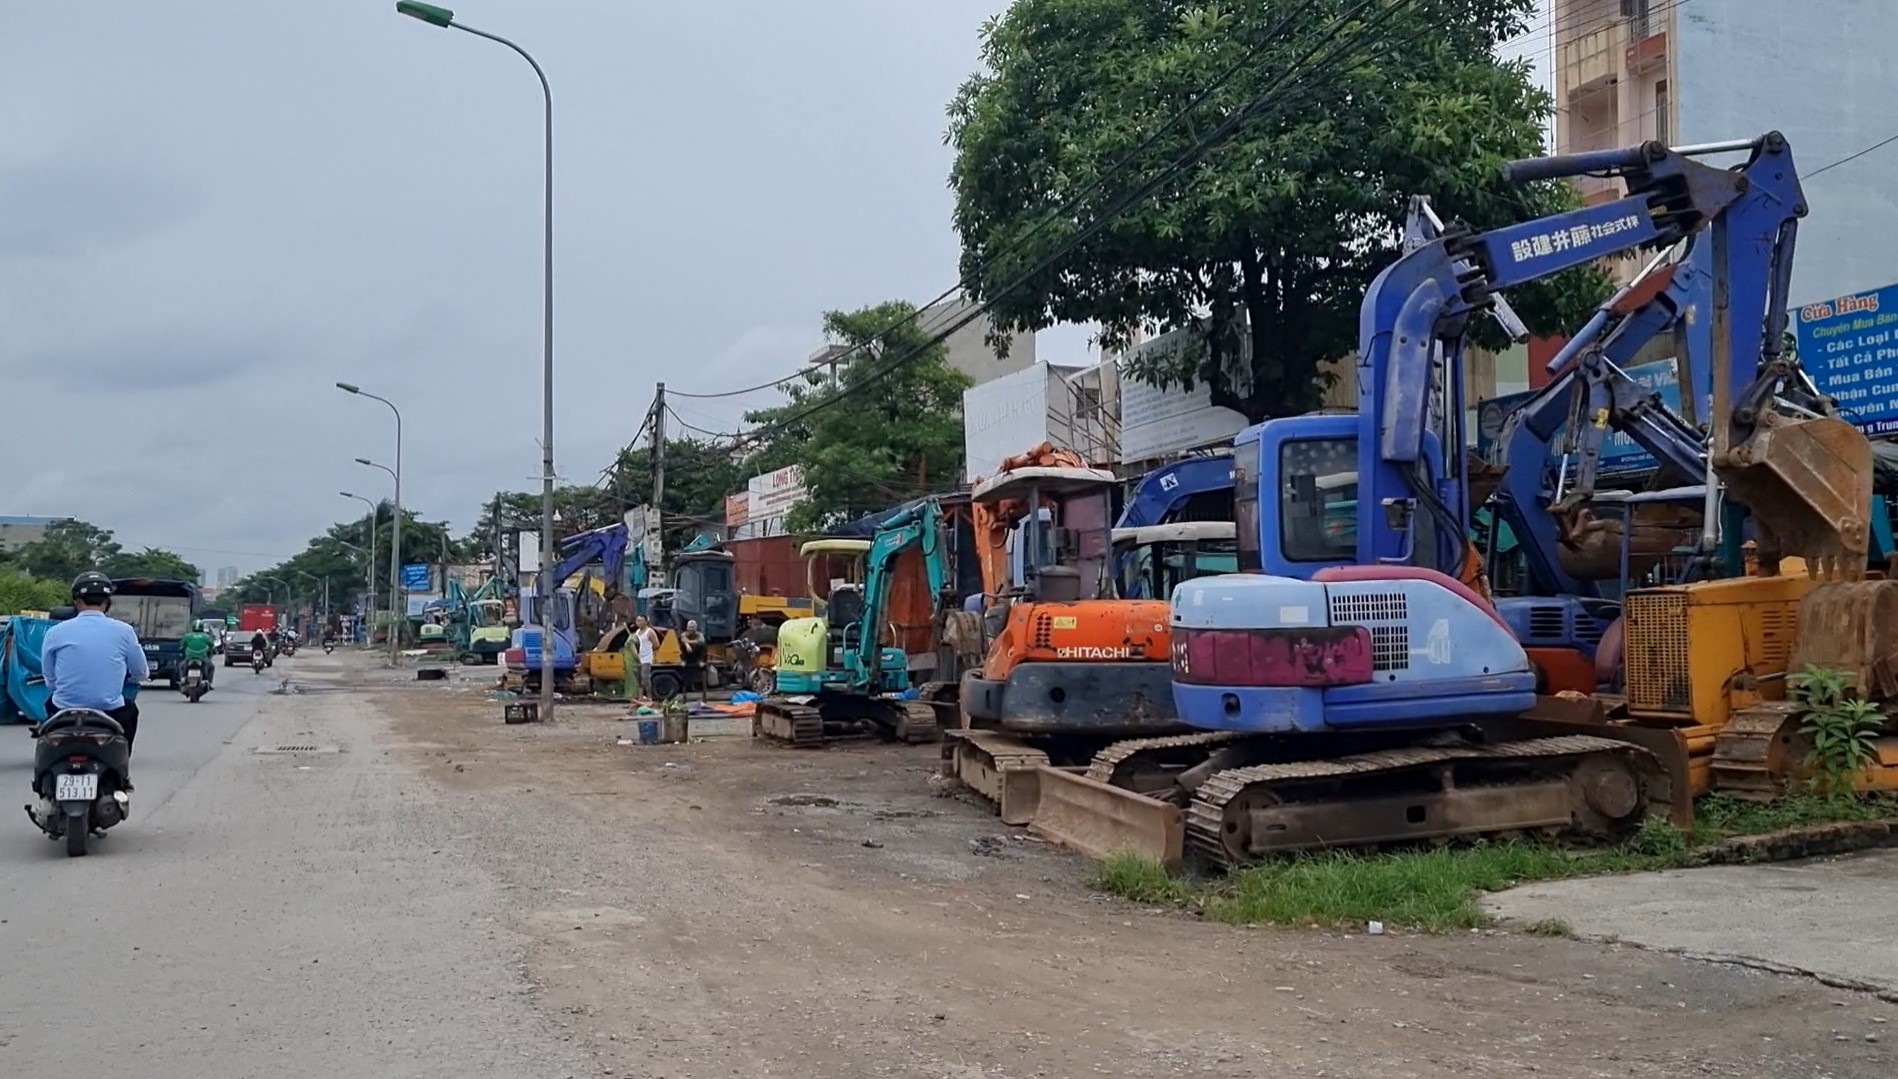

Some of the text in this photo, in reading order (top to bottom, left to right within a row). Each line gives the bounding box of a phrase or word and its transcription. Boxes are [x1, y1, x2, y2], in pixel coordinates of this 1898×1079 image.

[1852, 318, 1874, 331] Mua
[1826, 340, 1854, 353] Các
[1876, 347, 1898, 360] Ph
[1829, 367, 1893, 386] Mua Bán
[1066, 646, 1129, 658] HITACHI
[63, 775, 91, 787] 29-T1
[59, 787, 93, 799] 513.11
